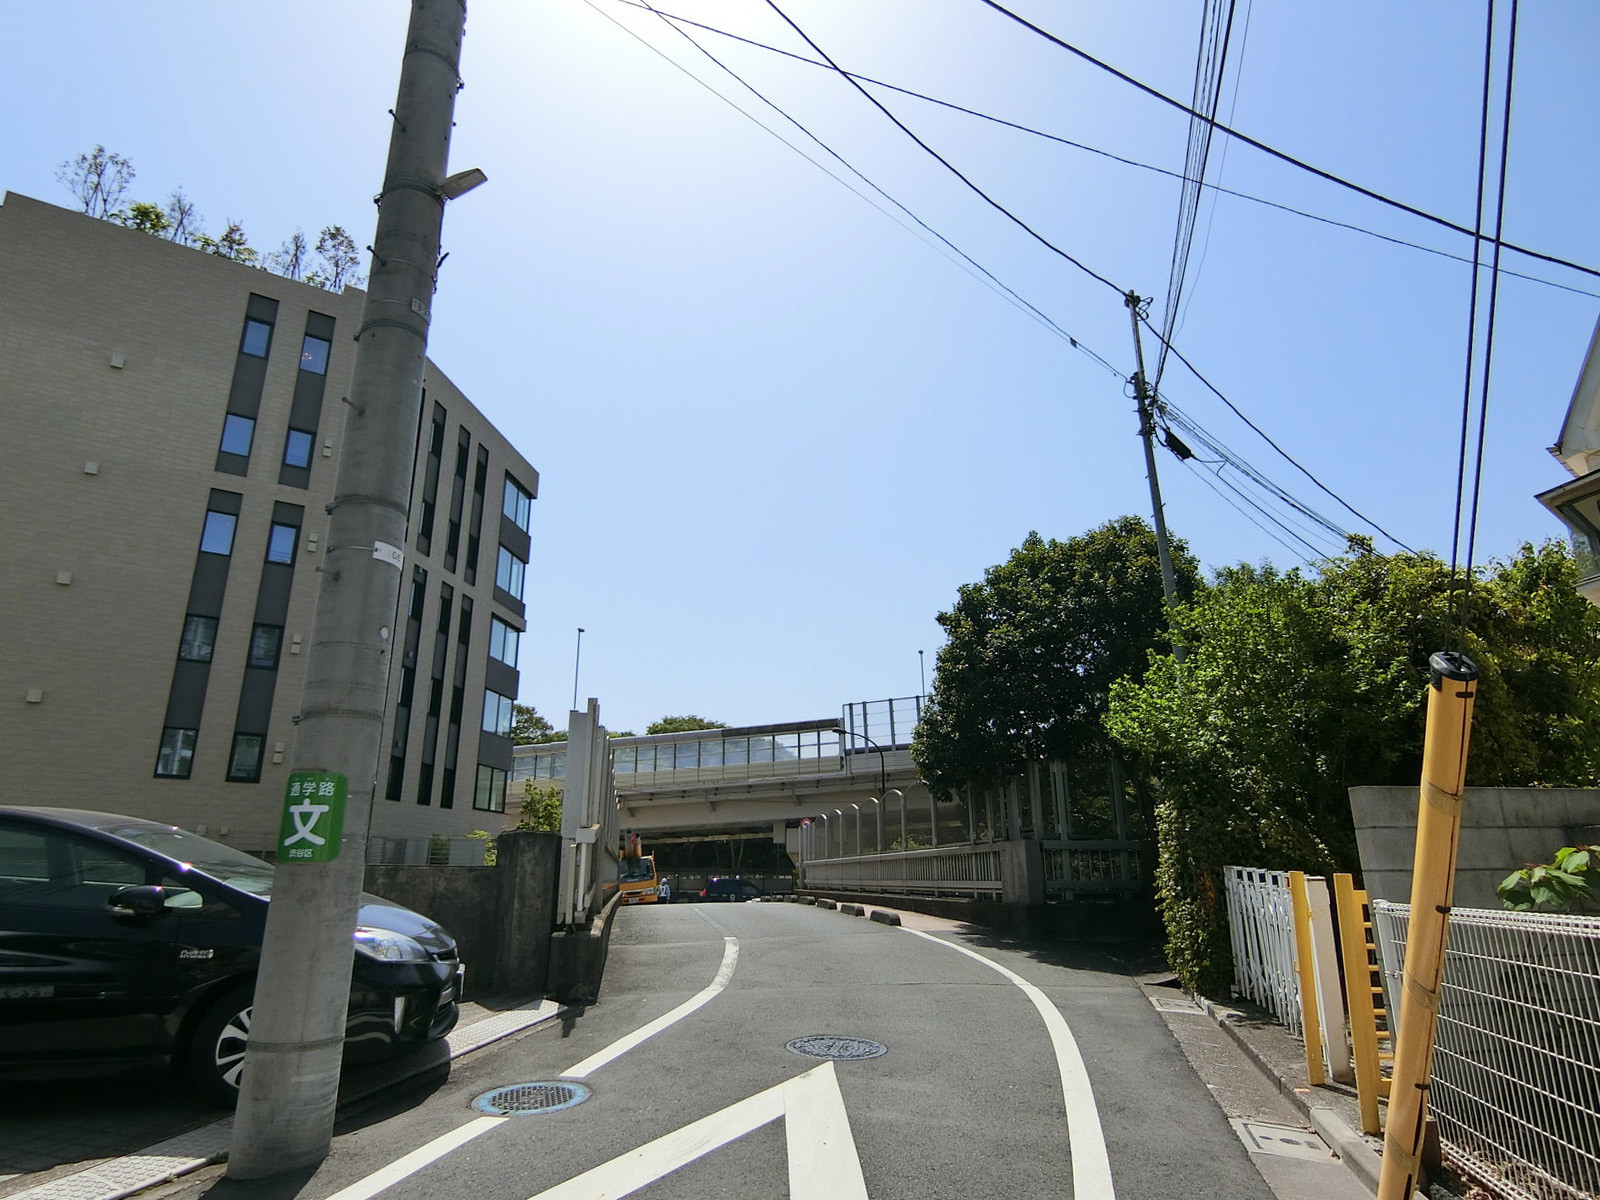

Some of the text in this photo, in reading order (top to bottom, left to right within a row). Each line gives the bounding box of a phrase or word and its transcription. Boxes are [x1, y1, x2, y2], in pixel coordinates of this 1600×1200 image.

[290, 781, 335, 796] 通学路
[284, 798, 329, 846] 文
